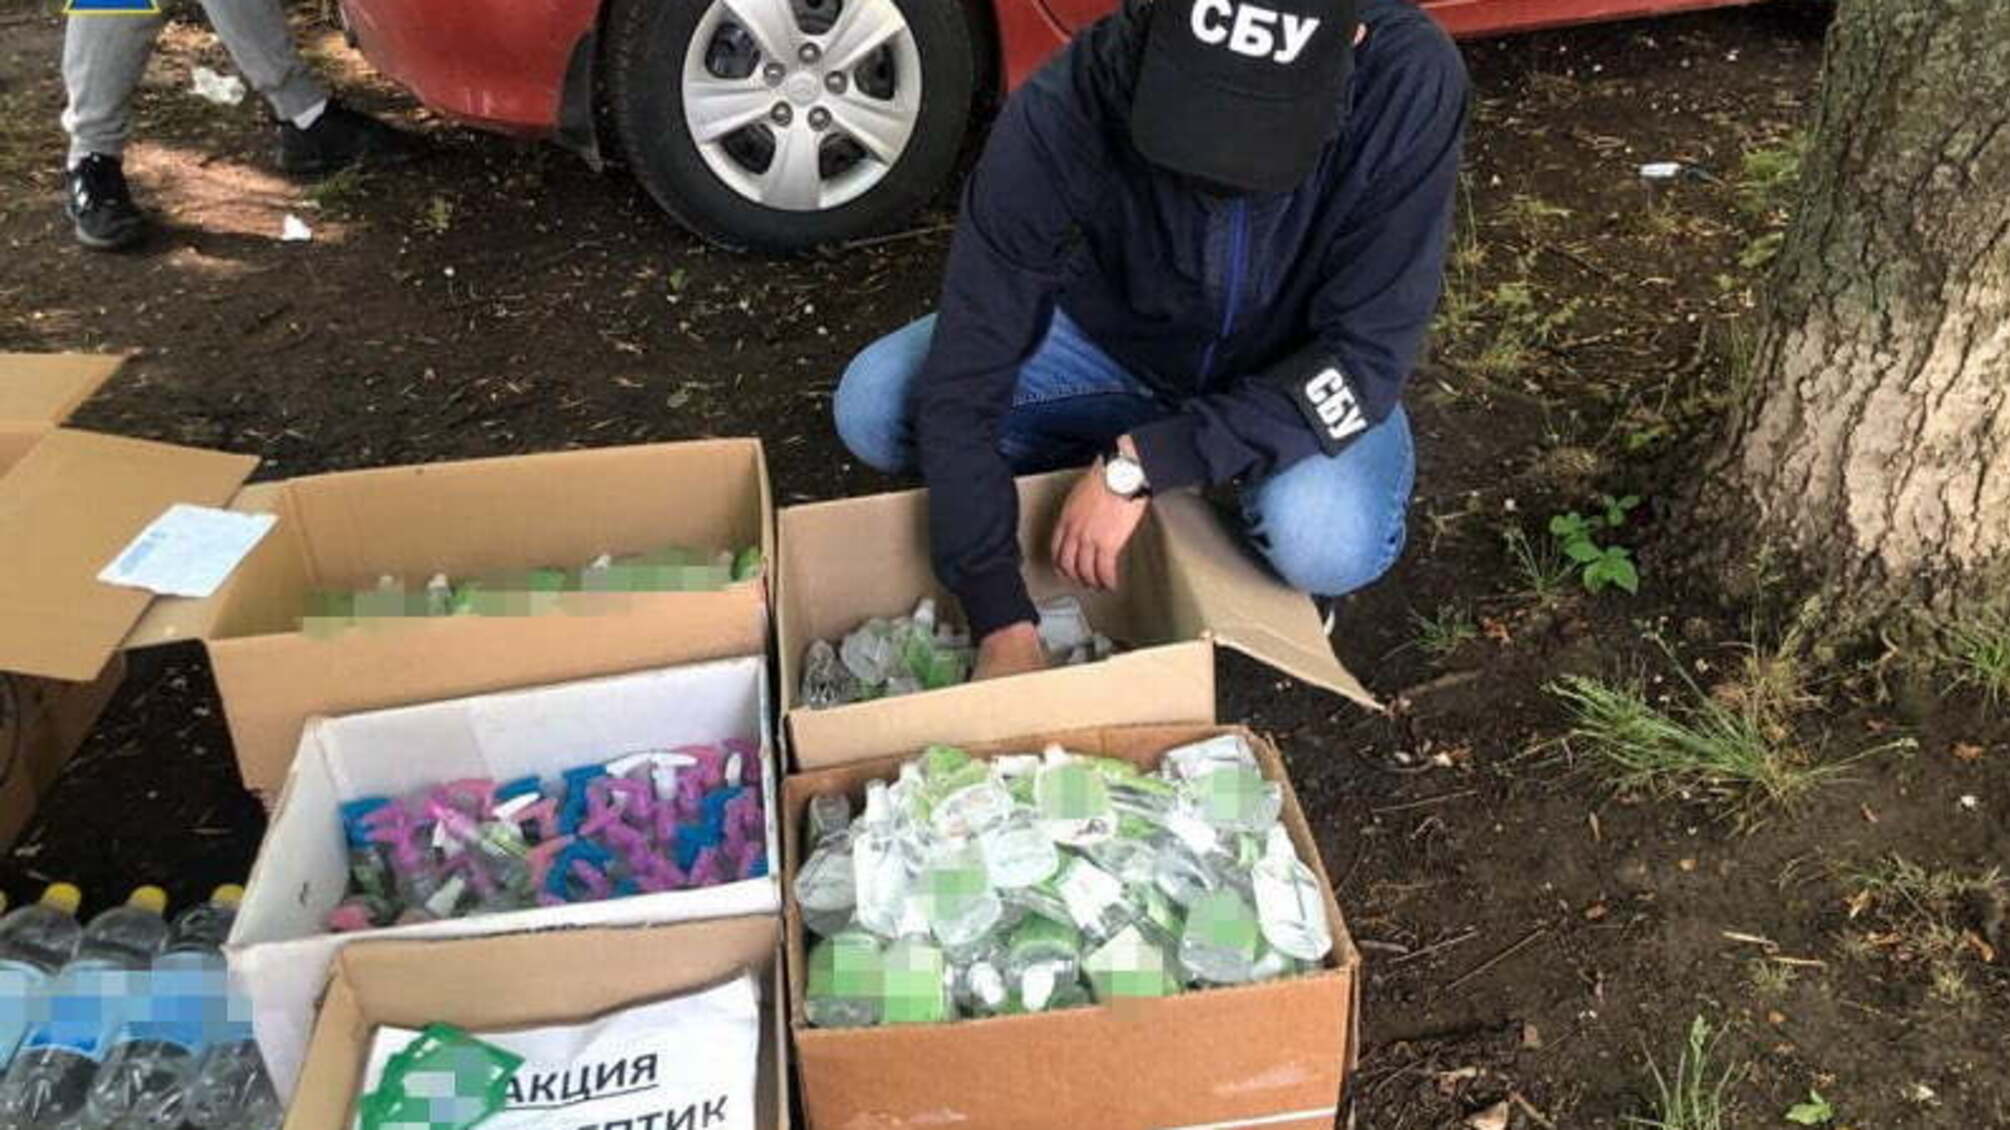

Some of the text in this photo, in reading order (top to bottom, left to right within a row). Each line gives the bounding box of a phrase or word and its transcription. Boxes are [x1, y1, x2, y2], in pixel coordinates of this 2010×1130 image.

[1190, 0, 1320, 64] СБУ
[1305, 367, 1367, 439] СБУ
[505, 1052, 659, 1103] АКЦИЯ
